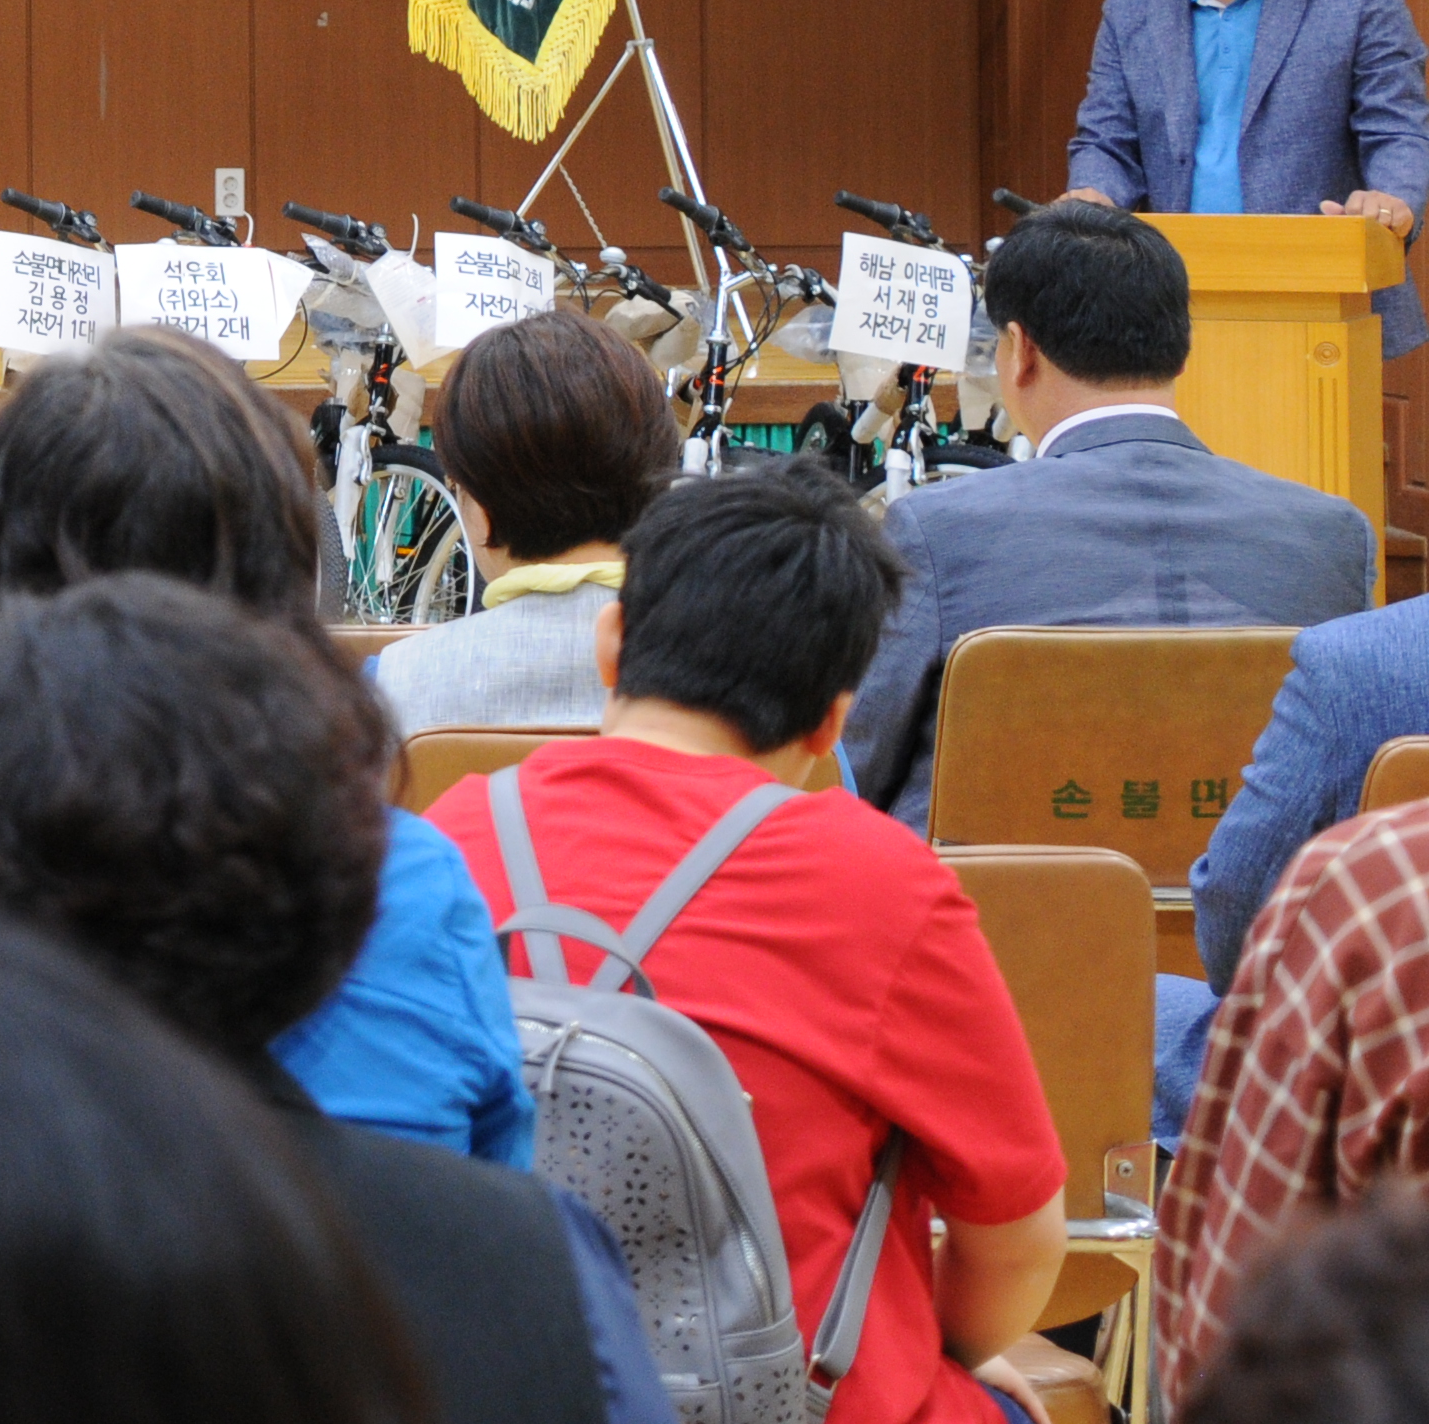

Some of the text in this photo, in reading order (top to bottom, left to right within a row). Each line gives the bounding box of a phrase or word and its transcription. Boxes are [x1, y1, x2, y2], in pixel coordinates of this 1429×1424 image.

[859, 252, 897, 282] 해남
[158, 287, 239, 313] (쥐와소)
[464, 292, 519, 323] 자전거
[17, 308, 96, 345] 자전거 1대
[217, 316, 250, 341] 2대
[859, 311, 946, 350] 자전거 2대
